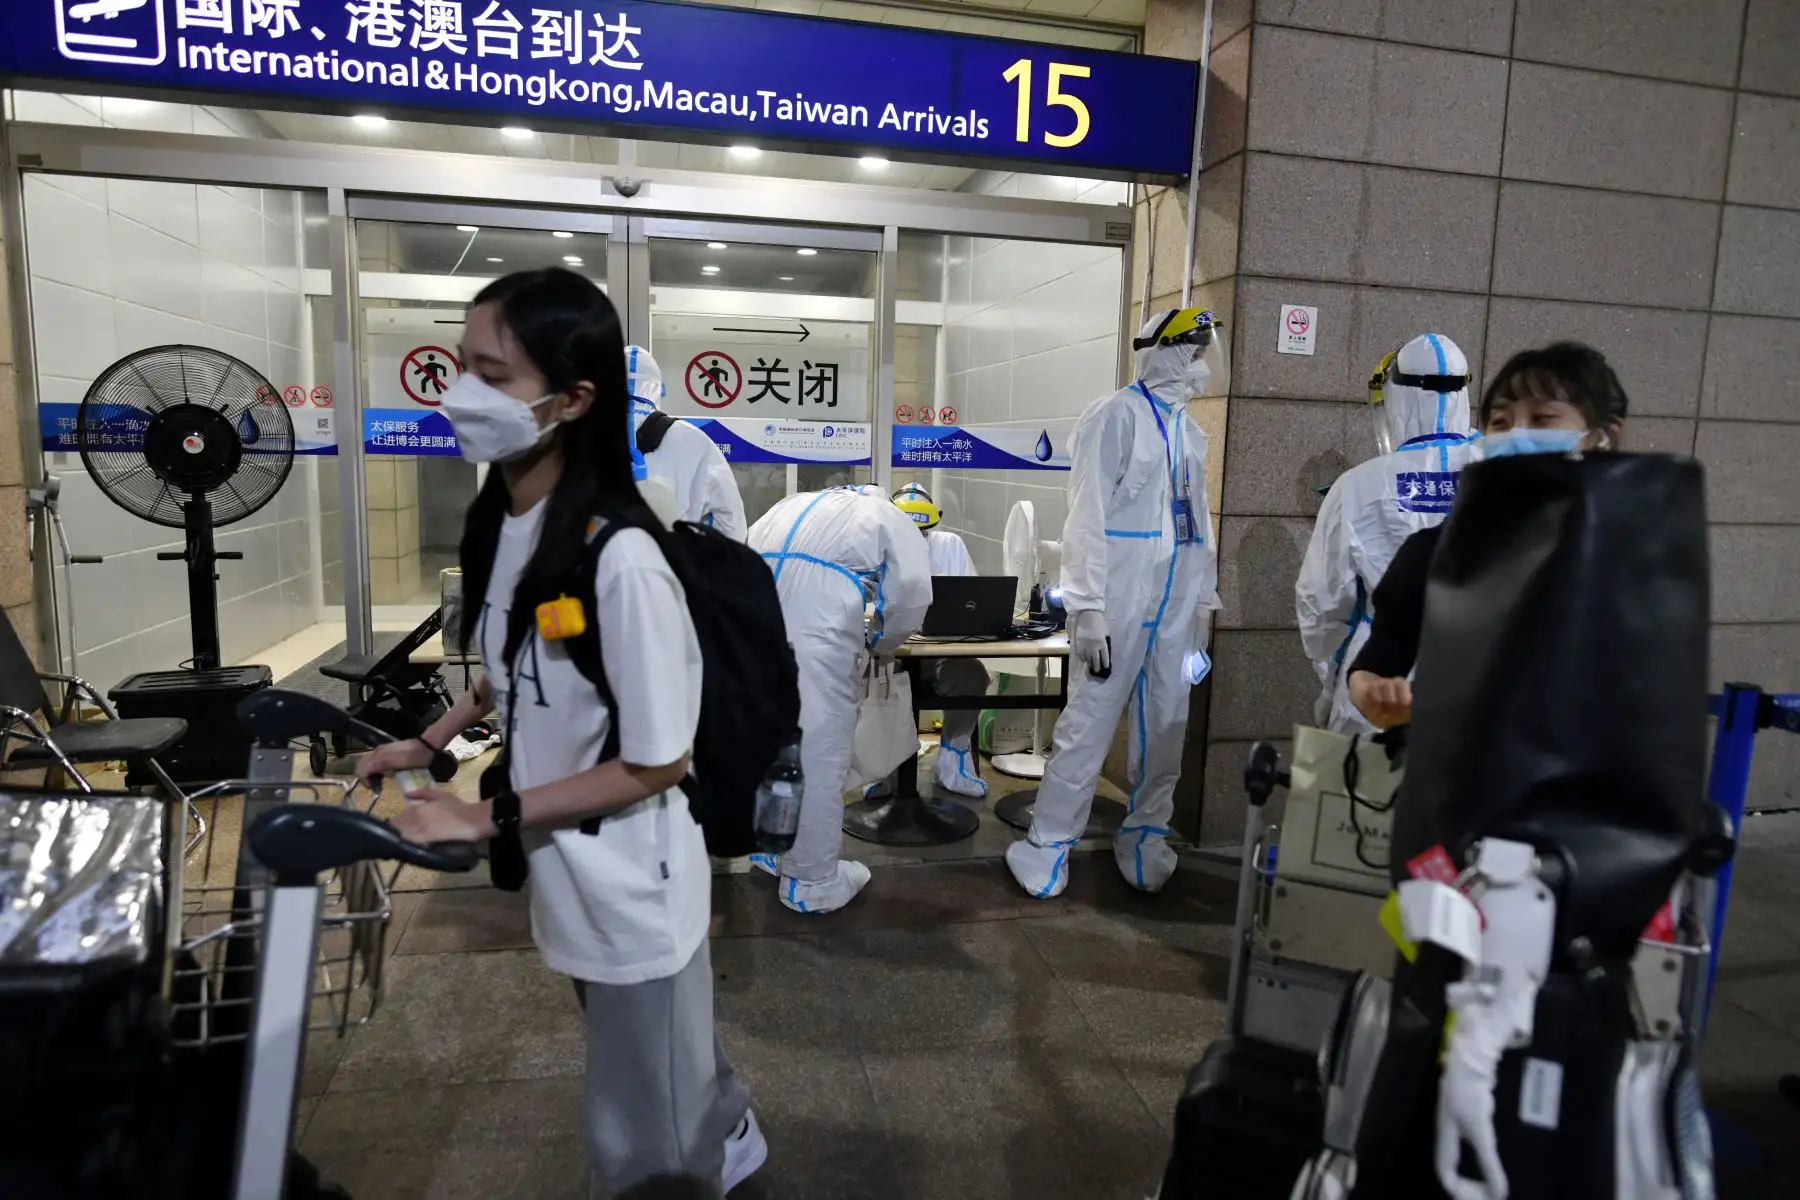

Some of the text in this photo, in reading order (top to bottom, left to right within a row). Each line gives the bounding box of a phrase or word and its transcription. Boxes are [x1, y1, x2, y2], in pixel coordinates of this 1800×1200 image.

[176, 0, 643, 70] 国际、港澳台到达
[1002, 59, 1092, 148] 15
[877, 103, 990, 139] Arrivals
[747, 357, 839, 408] 关闭
[371, 420, 419, 433] 太保服务
[371, 434, 456, 448] 让进博会更圆满
[901, 437, 973, 450] 平时注入一滴水
[901, 451, 972, 463] 难时拥有太平洋
[1405, 480, 1459, 496] 交通保
